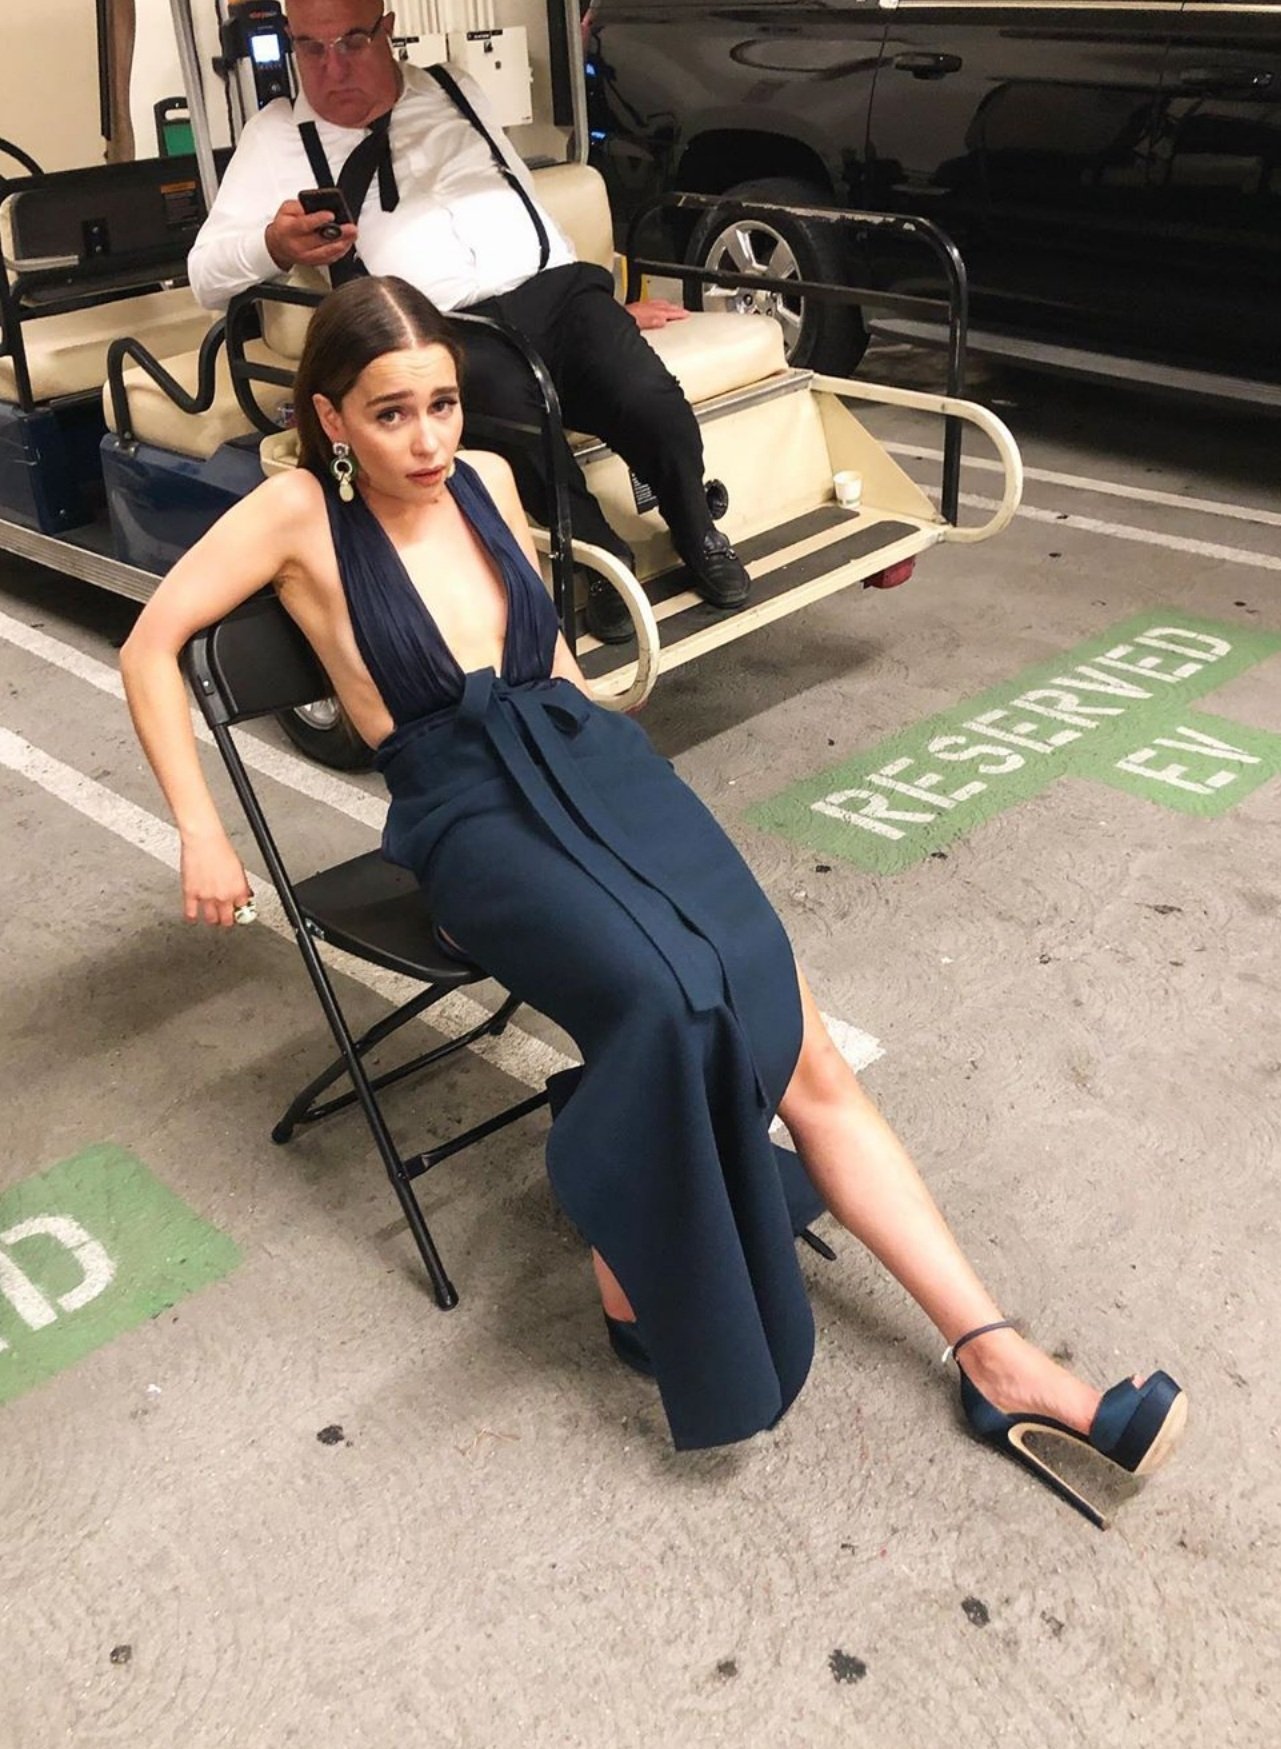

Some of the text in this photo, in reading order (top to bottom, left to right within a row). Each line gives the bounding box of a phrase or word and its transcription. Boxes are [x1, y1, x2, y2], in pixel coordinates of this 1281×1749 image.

[811, 627, 1232, 840] RESERVED
[1115, 726, 1262, 795] EV
[0, 1214, 117, 1352] D
